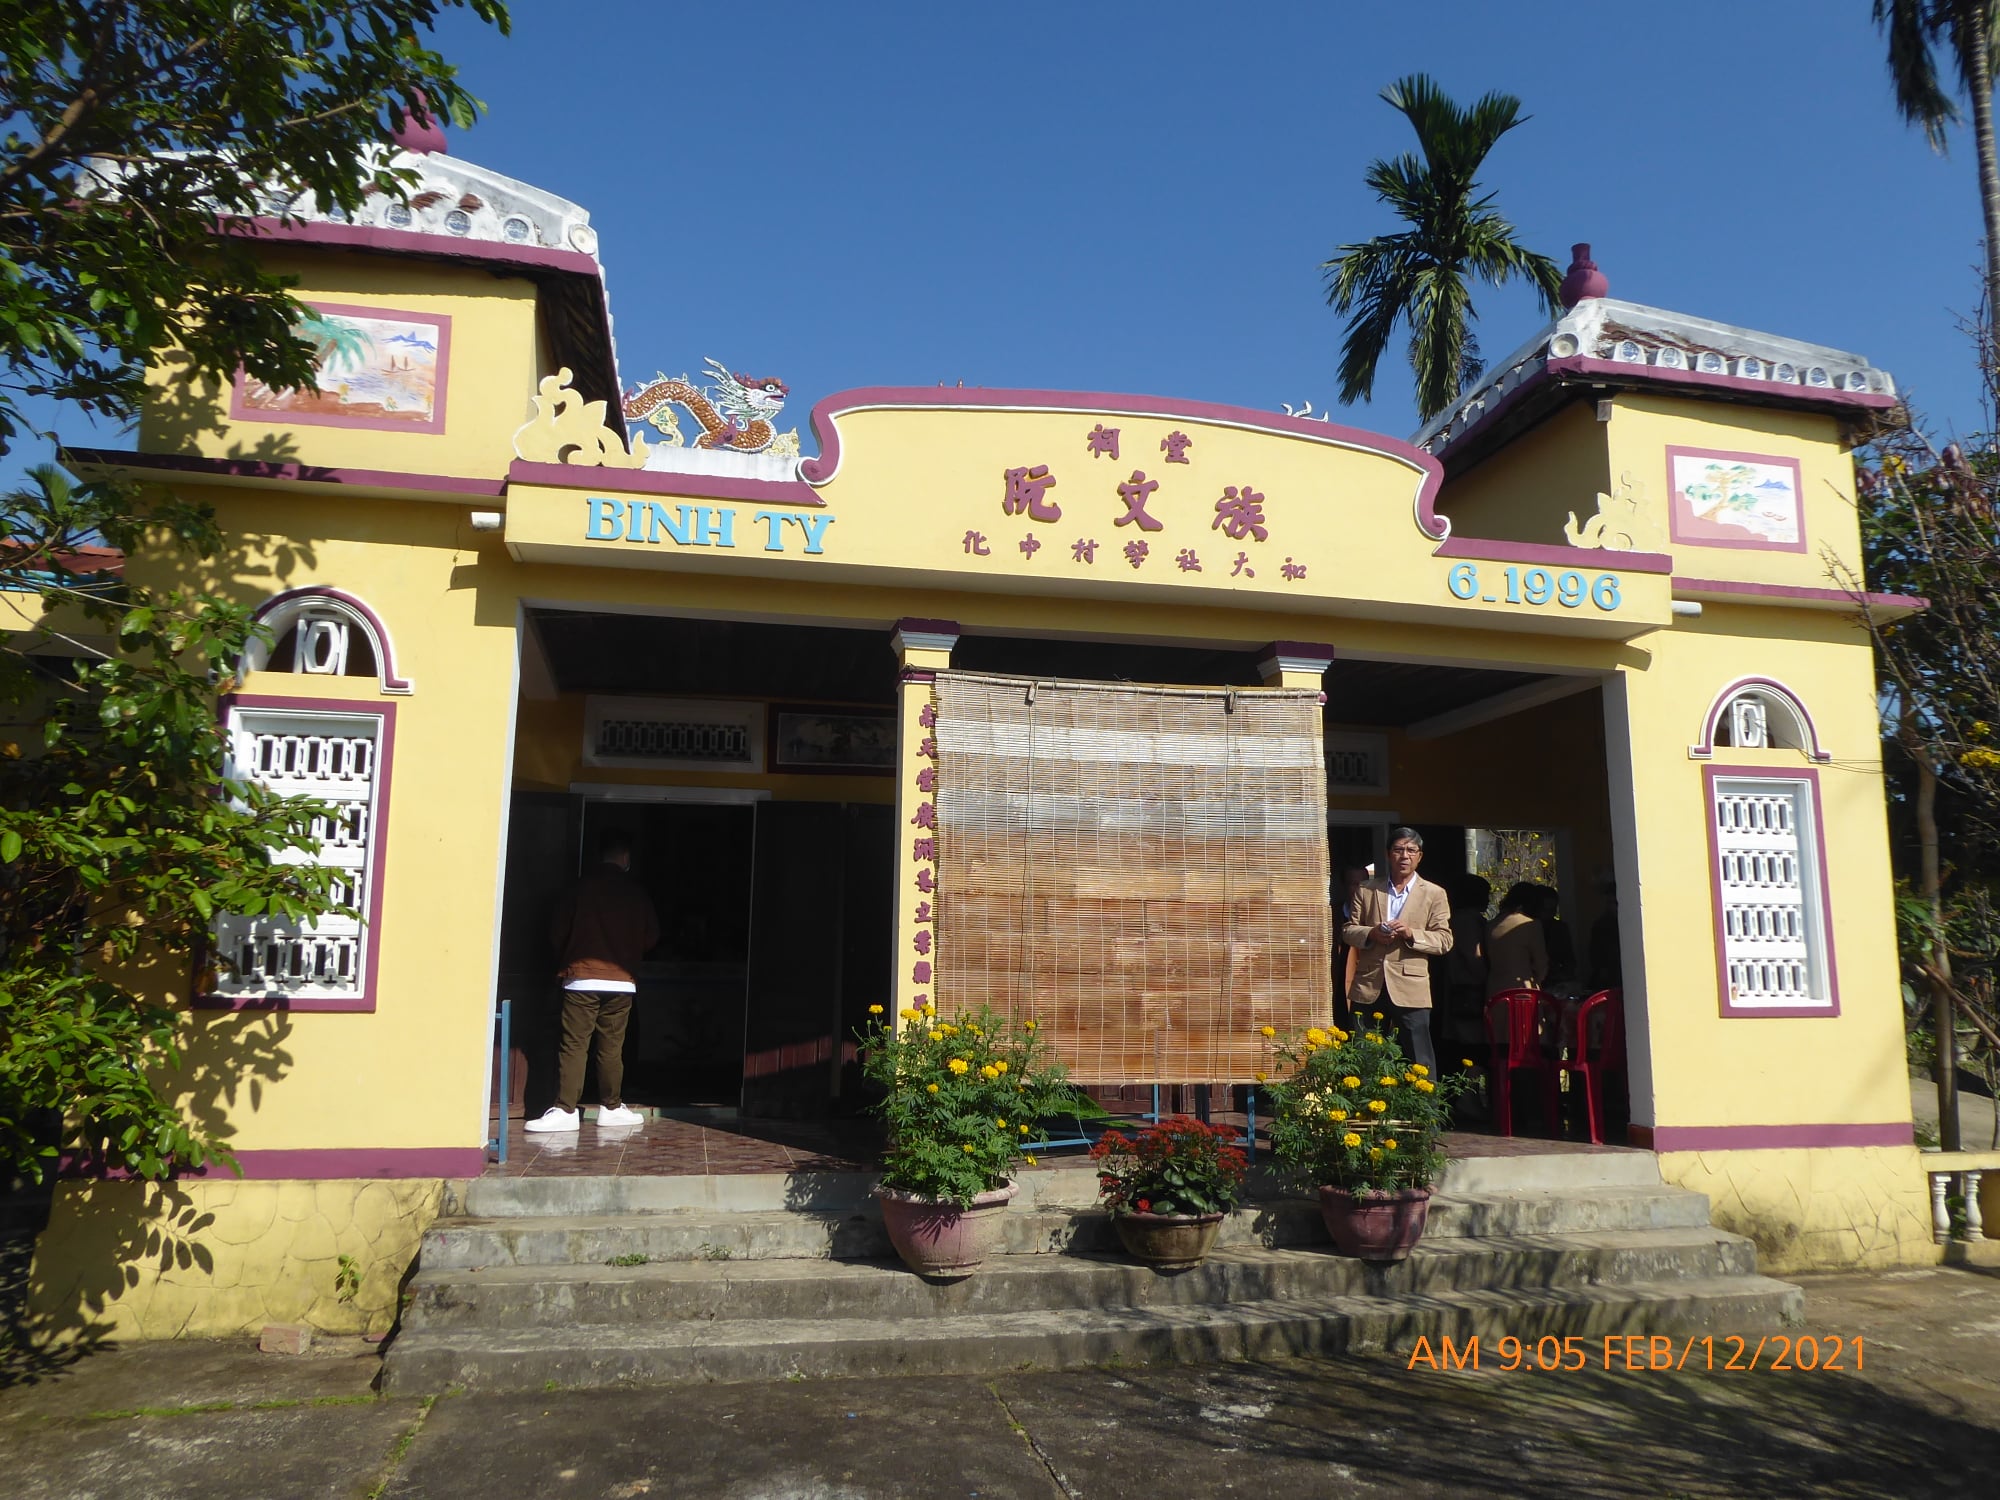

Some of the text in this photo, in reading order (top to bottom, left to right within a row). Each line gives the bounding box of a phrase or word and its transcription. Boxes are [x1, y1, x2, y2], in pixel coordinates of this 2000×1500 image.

[1087, 423, 1193, 465] 祠堂
[586, 497, 836, 554] BINH TY
[1002, 464, 1270, 543] 阮文族
